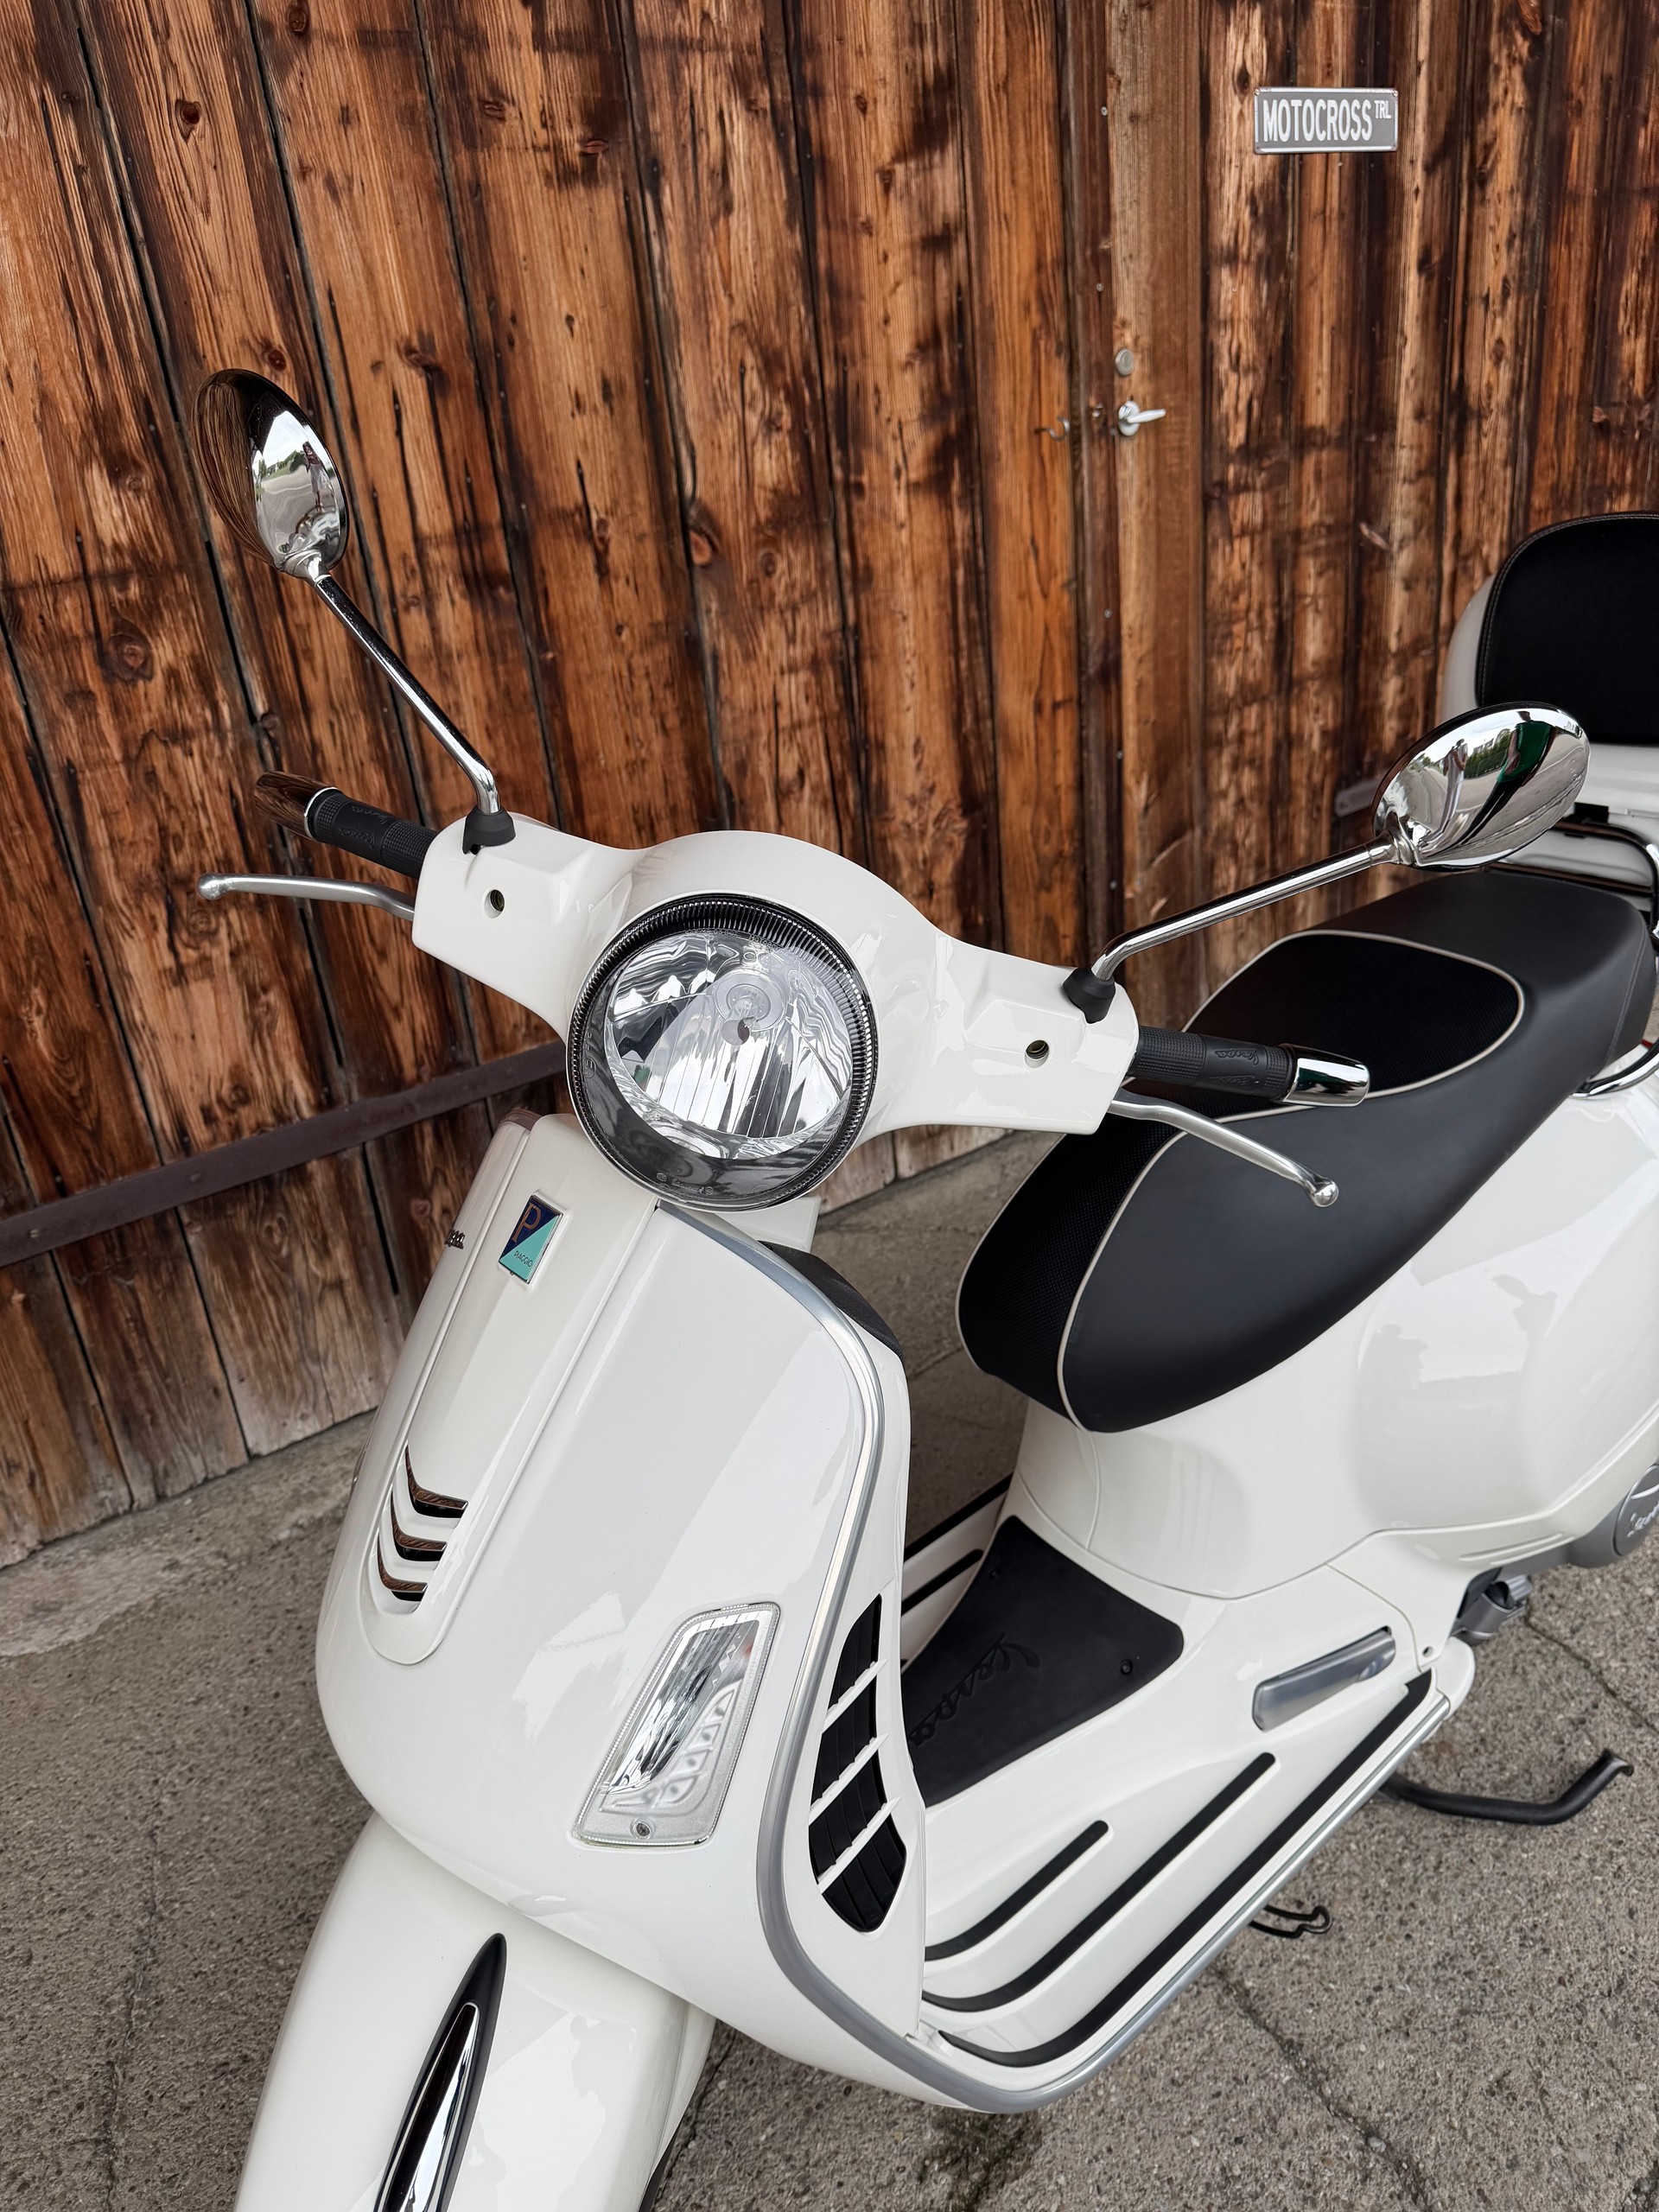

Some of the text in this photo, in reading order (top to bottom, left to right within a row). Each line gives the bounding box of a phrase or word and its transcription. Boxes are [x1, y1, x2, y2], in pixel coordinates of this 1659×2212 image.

[1262, 99, 1392, 142] MOTOCROSS TRL
[514, 1250, 534, 1268] PIAGGIO
[908, 1632, 1040, 1748] Vespa
